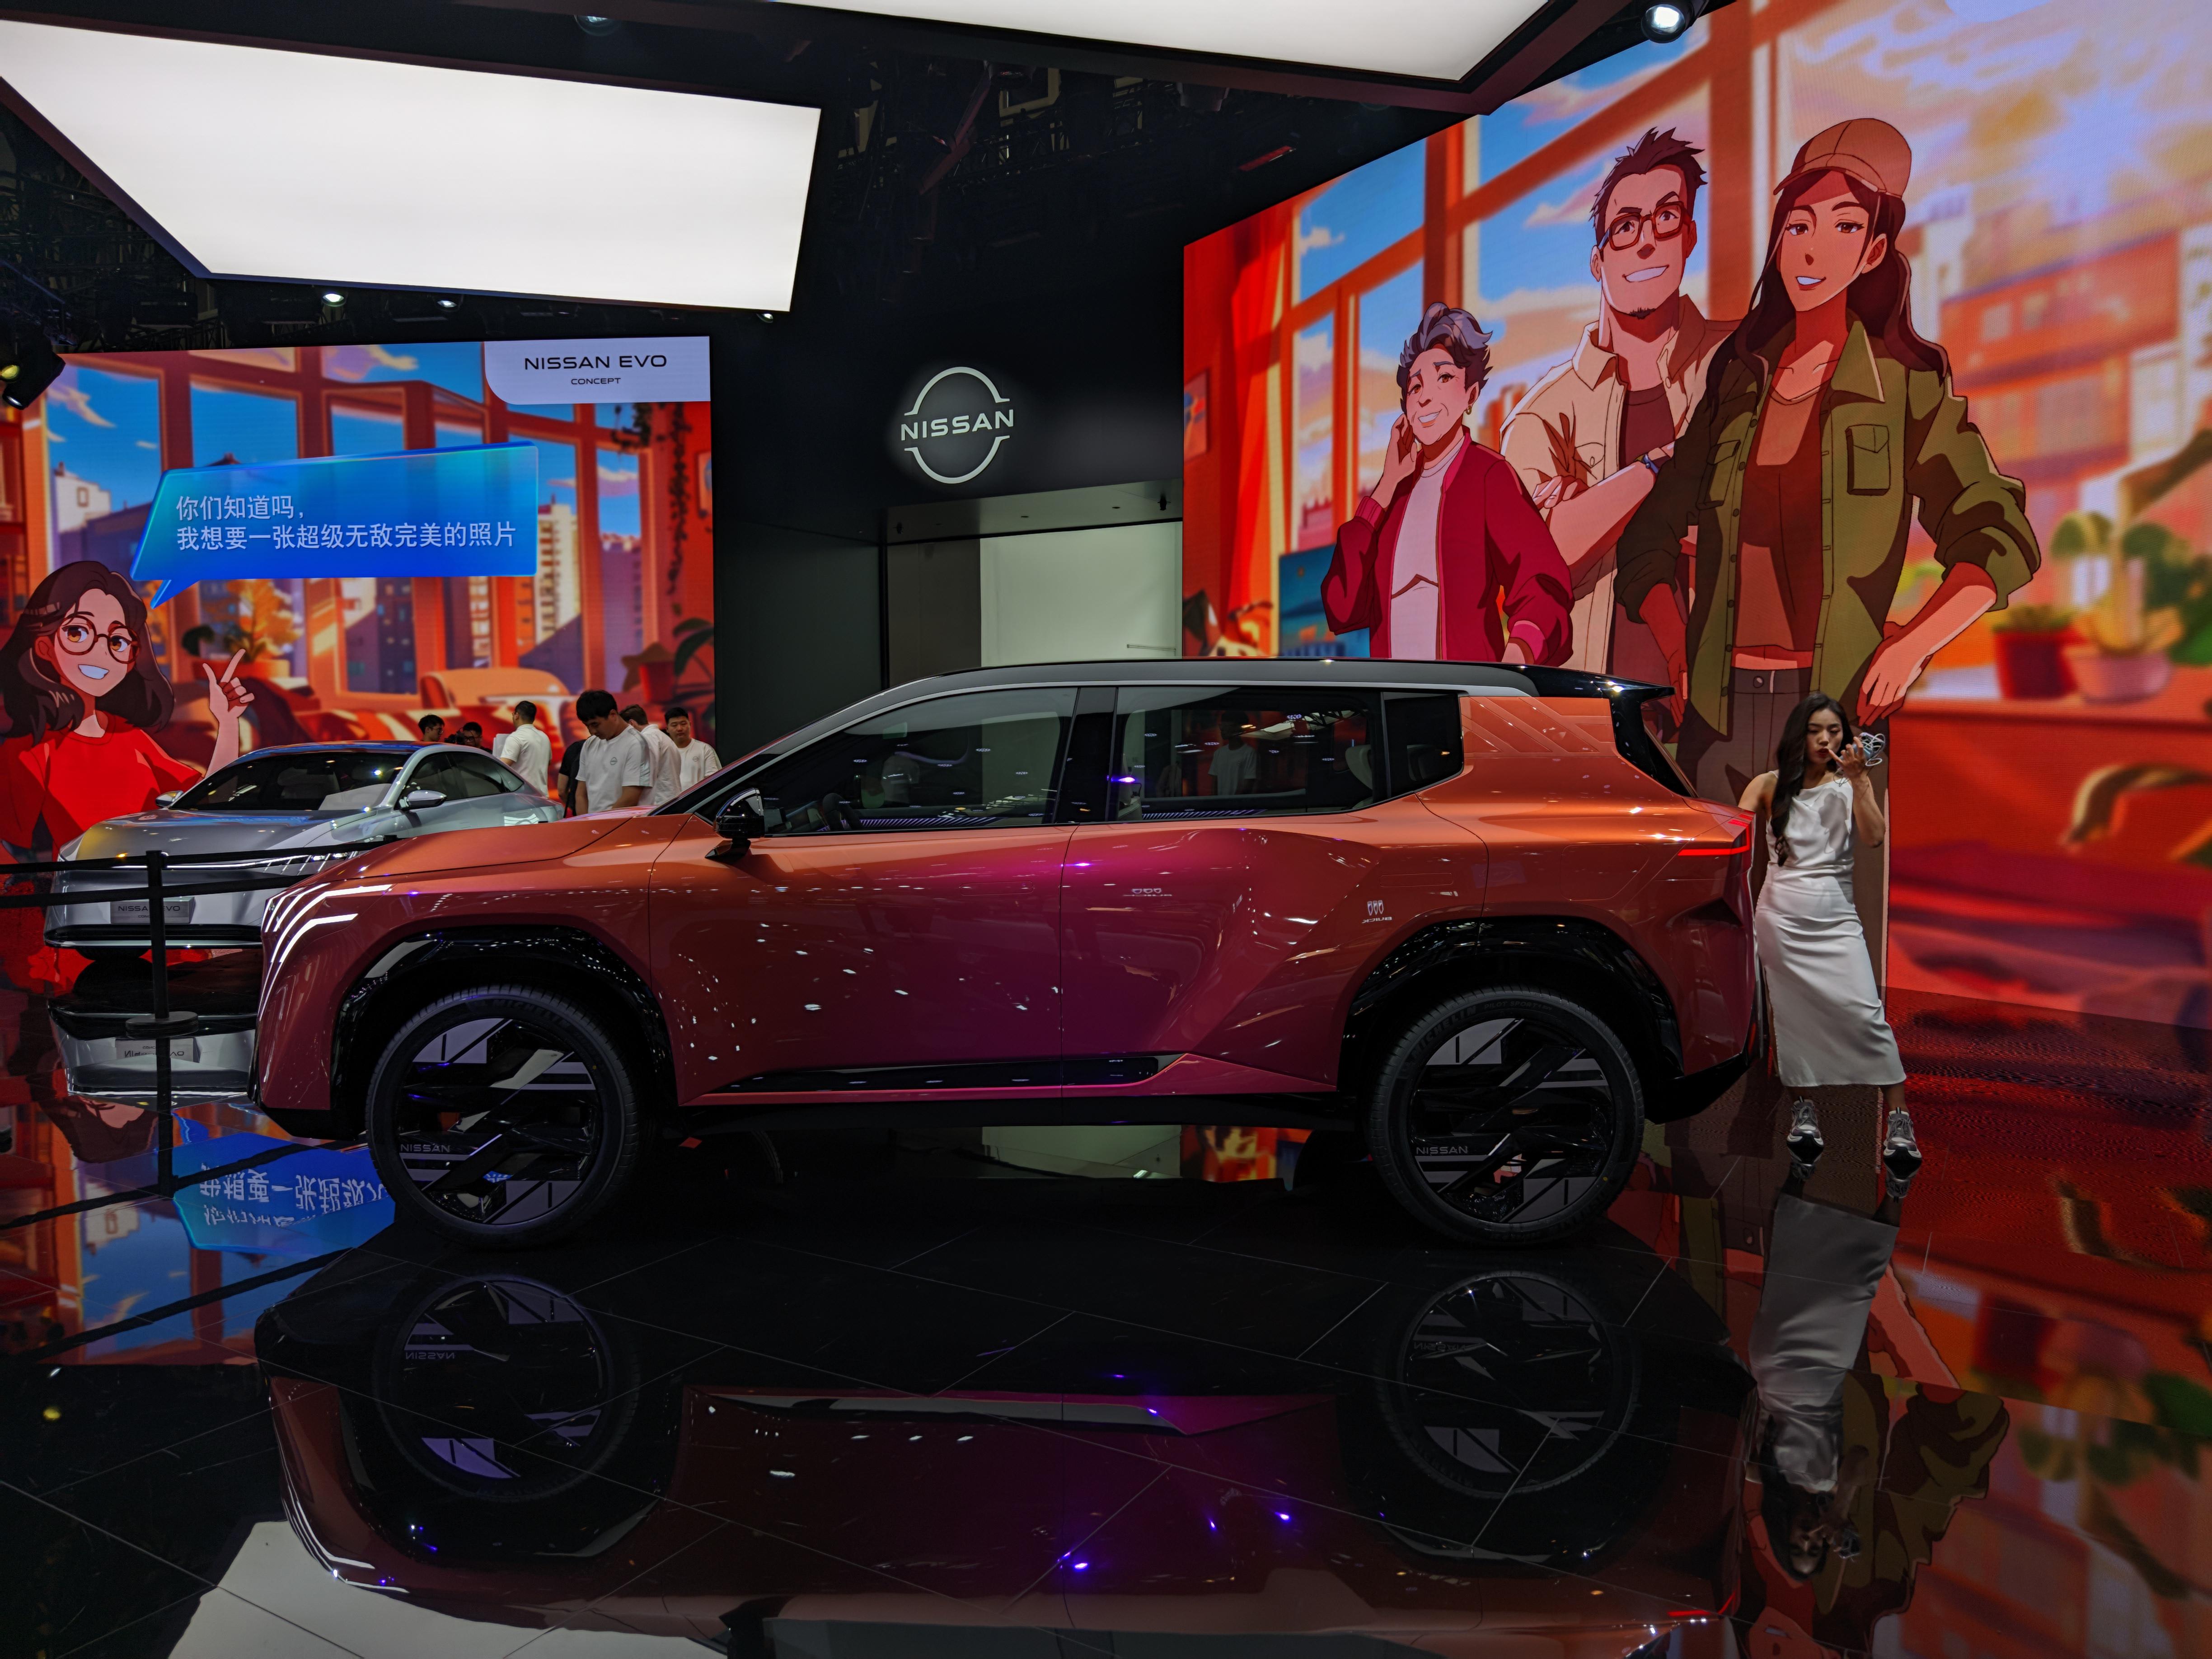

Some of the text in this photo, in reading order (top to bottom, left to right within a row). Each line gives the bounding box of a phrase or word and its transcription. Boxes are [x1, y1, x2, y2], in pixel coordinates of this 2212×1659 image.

[525, 355, 667, 370] NISSAN EVO
[900, 409, 1015, 441] NISSAN
[176, 495, 304, 521] 你们知道吗，
[177, 520, 516, 551] 我想要一张超级无敌完美的照片
[1484, 1001, 1509, 1010] PILOT
[400, 1143, 451, 1153] NISSAN
[1416, 1146, 1468, 1154] NISSAN
